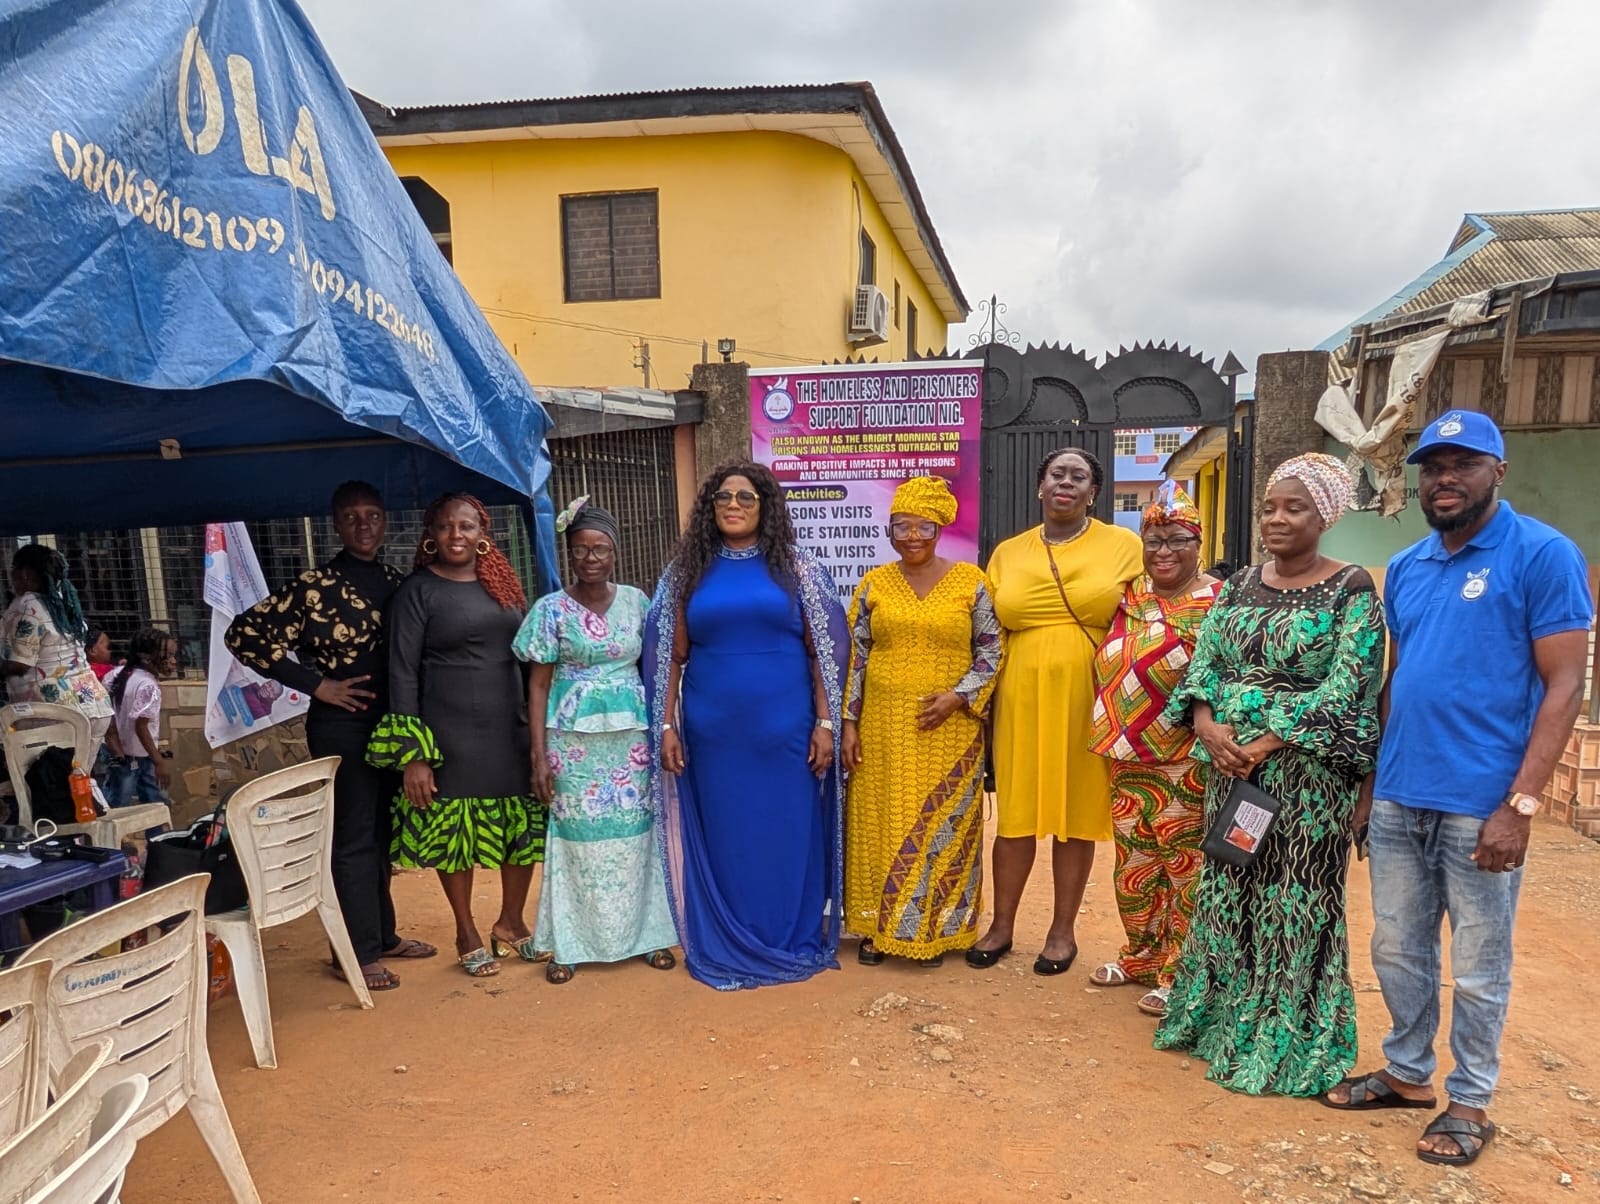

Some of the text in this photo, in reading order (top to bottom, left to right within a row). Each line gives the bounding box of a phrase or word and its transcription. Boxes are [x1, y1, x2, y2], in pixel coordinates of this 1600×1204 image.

[178, 25, 336, 221] OLA
[796, 374, 978, 403] THE HOMELESS AND PRISONERS
[809, 405, 861, 429] SUPPORT
[862, 403, 935, 427] FOUNDATION
[938, 401, 965, 426] NIG.
[771, 431, 960, 447] (ALSO KNOWN AS THE BRIGHT MORNING STAR
[810, 445, 828, 454] AND
[830, 443, 896, 454] HOMELESSNESS
[898, 442, 941, 452] OUTREACH
[943, 441, 959, 452] UK)
[775, 457, 956, 471] MAKING POSITIVE IMPACTS IN THE PRISONS
[800, 471, 818, 480] AND
[820, 469, 879, 480] COMMUNITIES
[881, 469, 907, 478] SINCE
[785, 488, 845, 500] Activities:
[788, 505, 873, 519] SONS VISITS
[818, 525, 880, 539] STATIONS
[834, 544, 876, 558] VISITS
